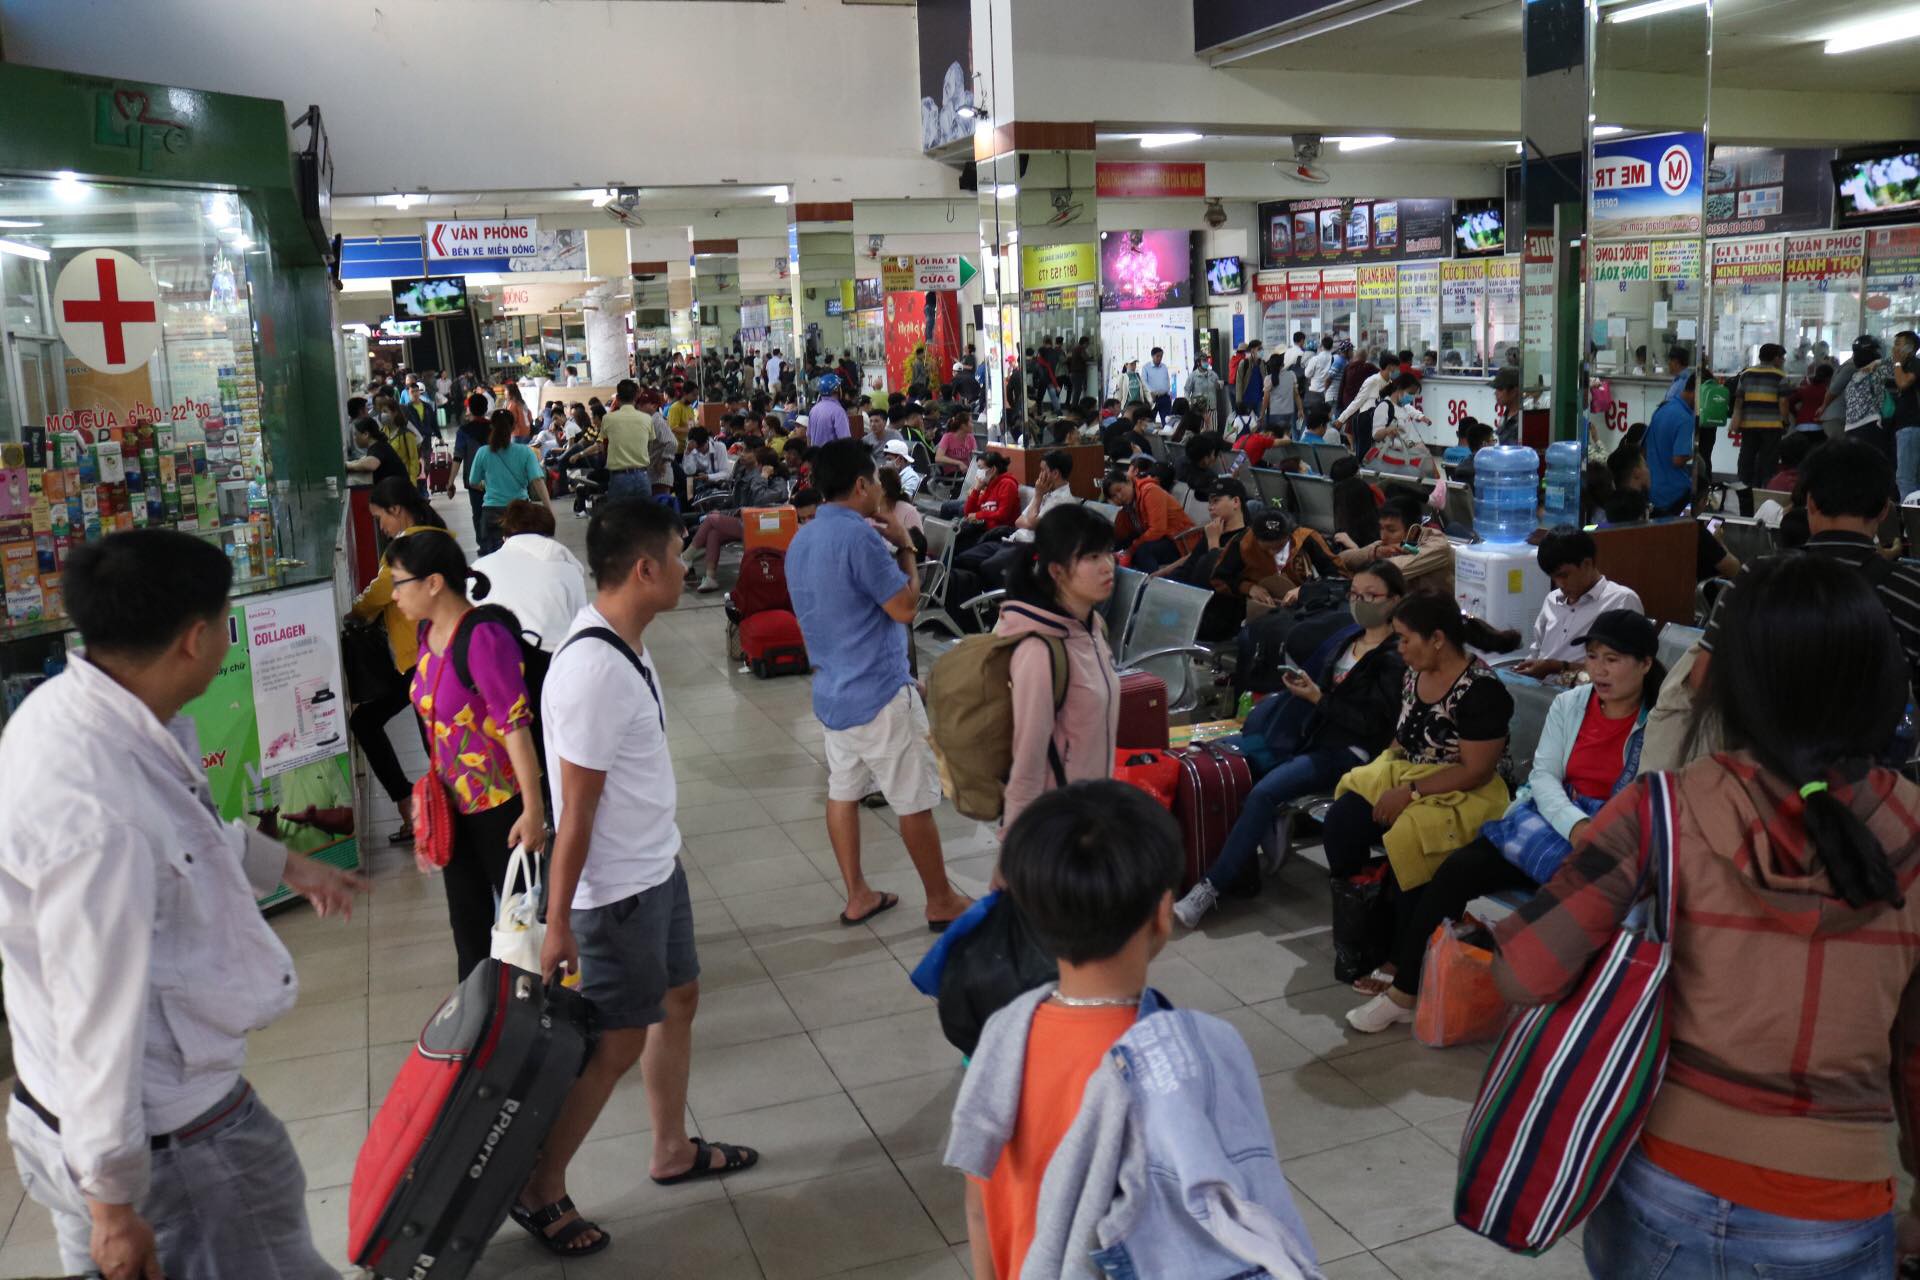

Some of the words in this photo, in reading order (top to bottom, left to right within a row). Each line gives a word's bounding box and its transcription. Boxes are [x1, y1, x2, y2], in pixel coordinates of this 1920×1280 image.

[451, 224, 478, 240] VĂN
[484, 222, 528, 239] PHÒNG
[1826, 233, 1862, 249] PHÚC
[452, 244, 469, 256] BẾN
[473, 247, 484, 256] XE
[487, 243, 509, 255] MIỀN
[512, 243, 535, 254] ĐÔNG
[915, 256, 929, 265] LỐI
[1444, 263, 1460, 280] CÚC
[1716, 265, 1740, 277] MINH
[920, 272, 944, 284] CỬA
[1324, 285, 1339, 294] PHAN
[1817, 279, 1829, 292] 42
[46, 407, 76, 433] MỞ
[80, 404, 118, 429] CỬA
[254, 623, 306, 646] COLLAGEN
